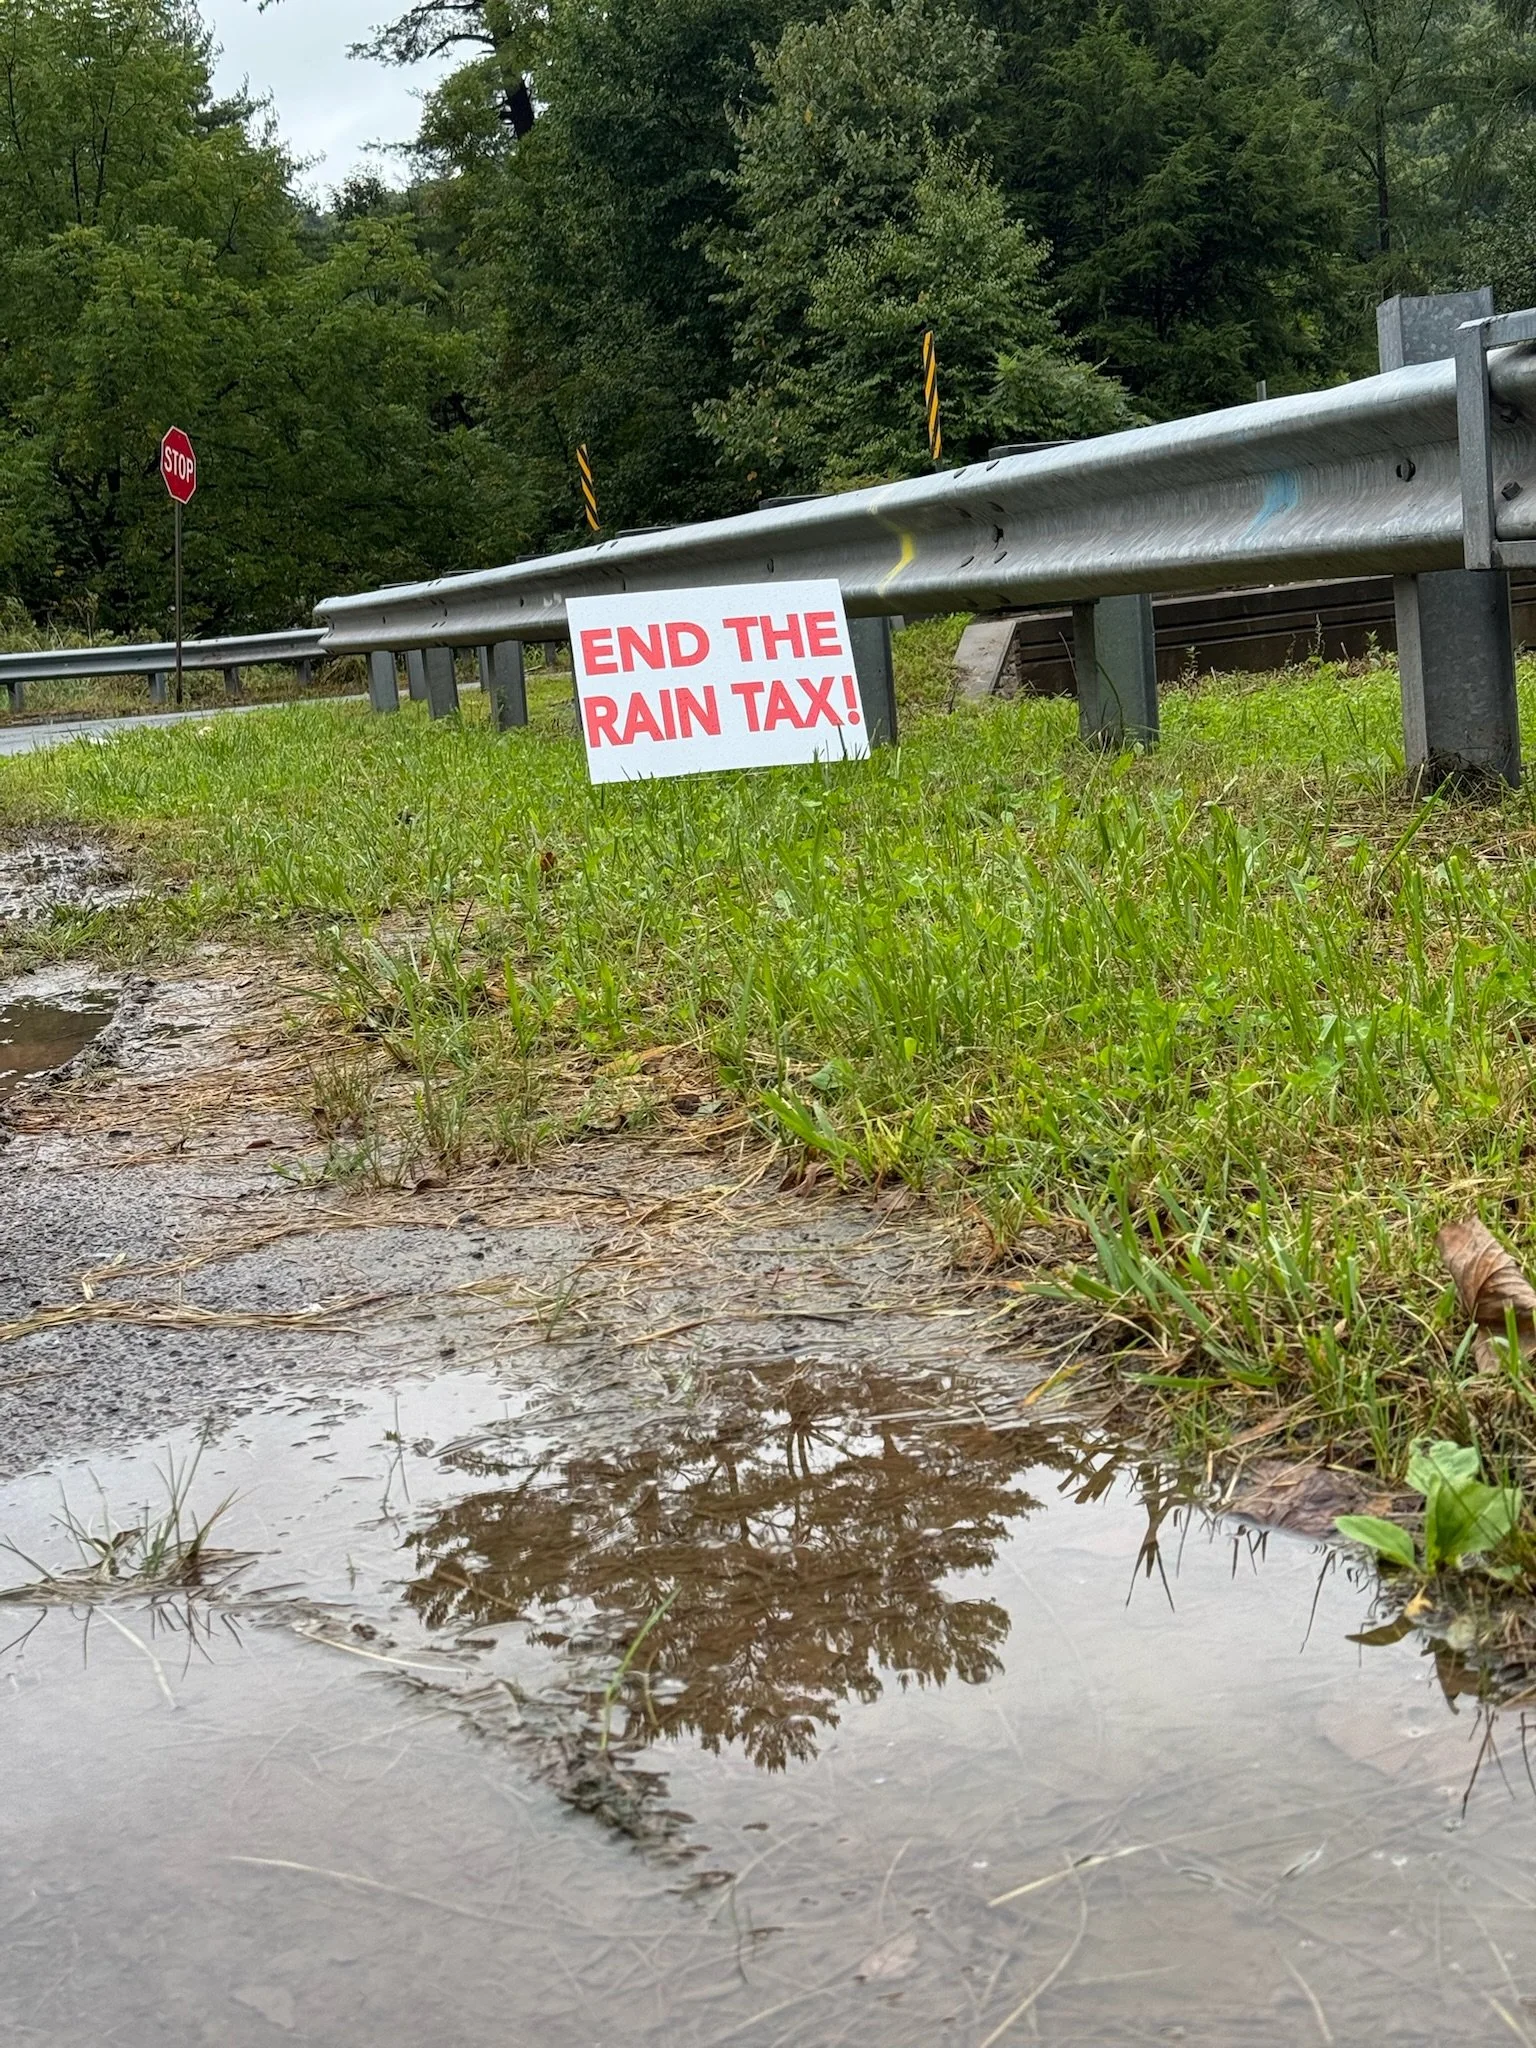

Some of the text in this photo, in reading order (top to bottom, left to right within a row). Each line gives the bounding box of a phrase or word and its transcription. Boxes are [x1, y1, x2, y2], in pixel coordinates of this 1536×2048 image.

[164, 446, 194, 483] STOP
[580, 611, 843, 676] END THE
[583, 675, 861, 748] RAIN TAX!
